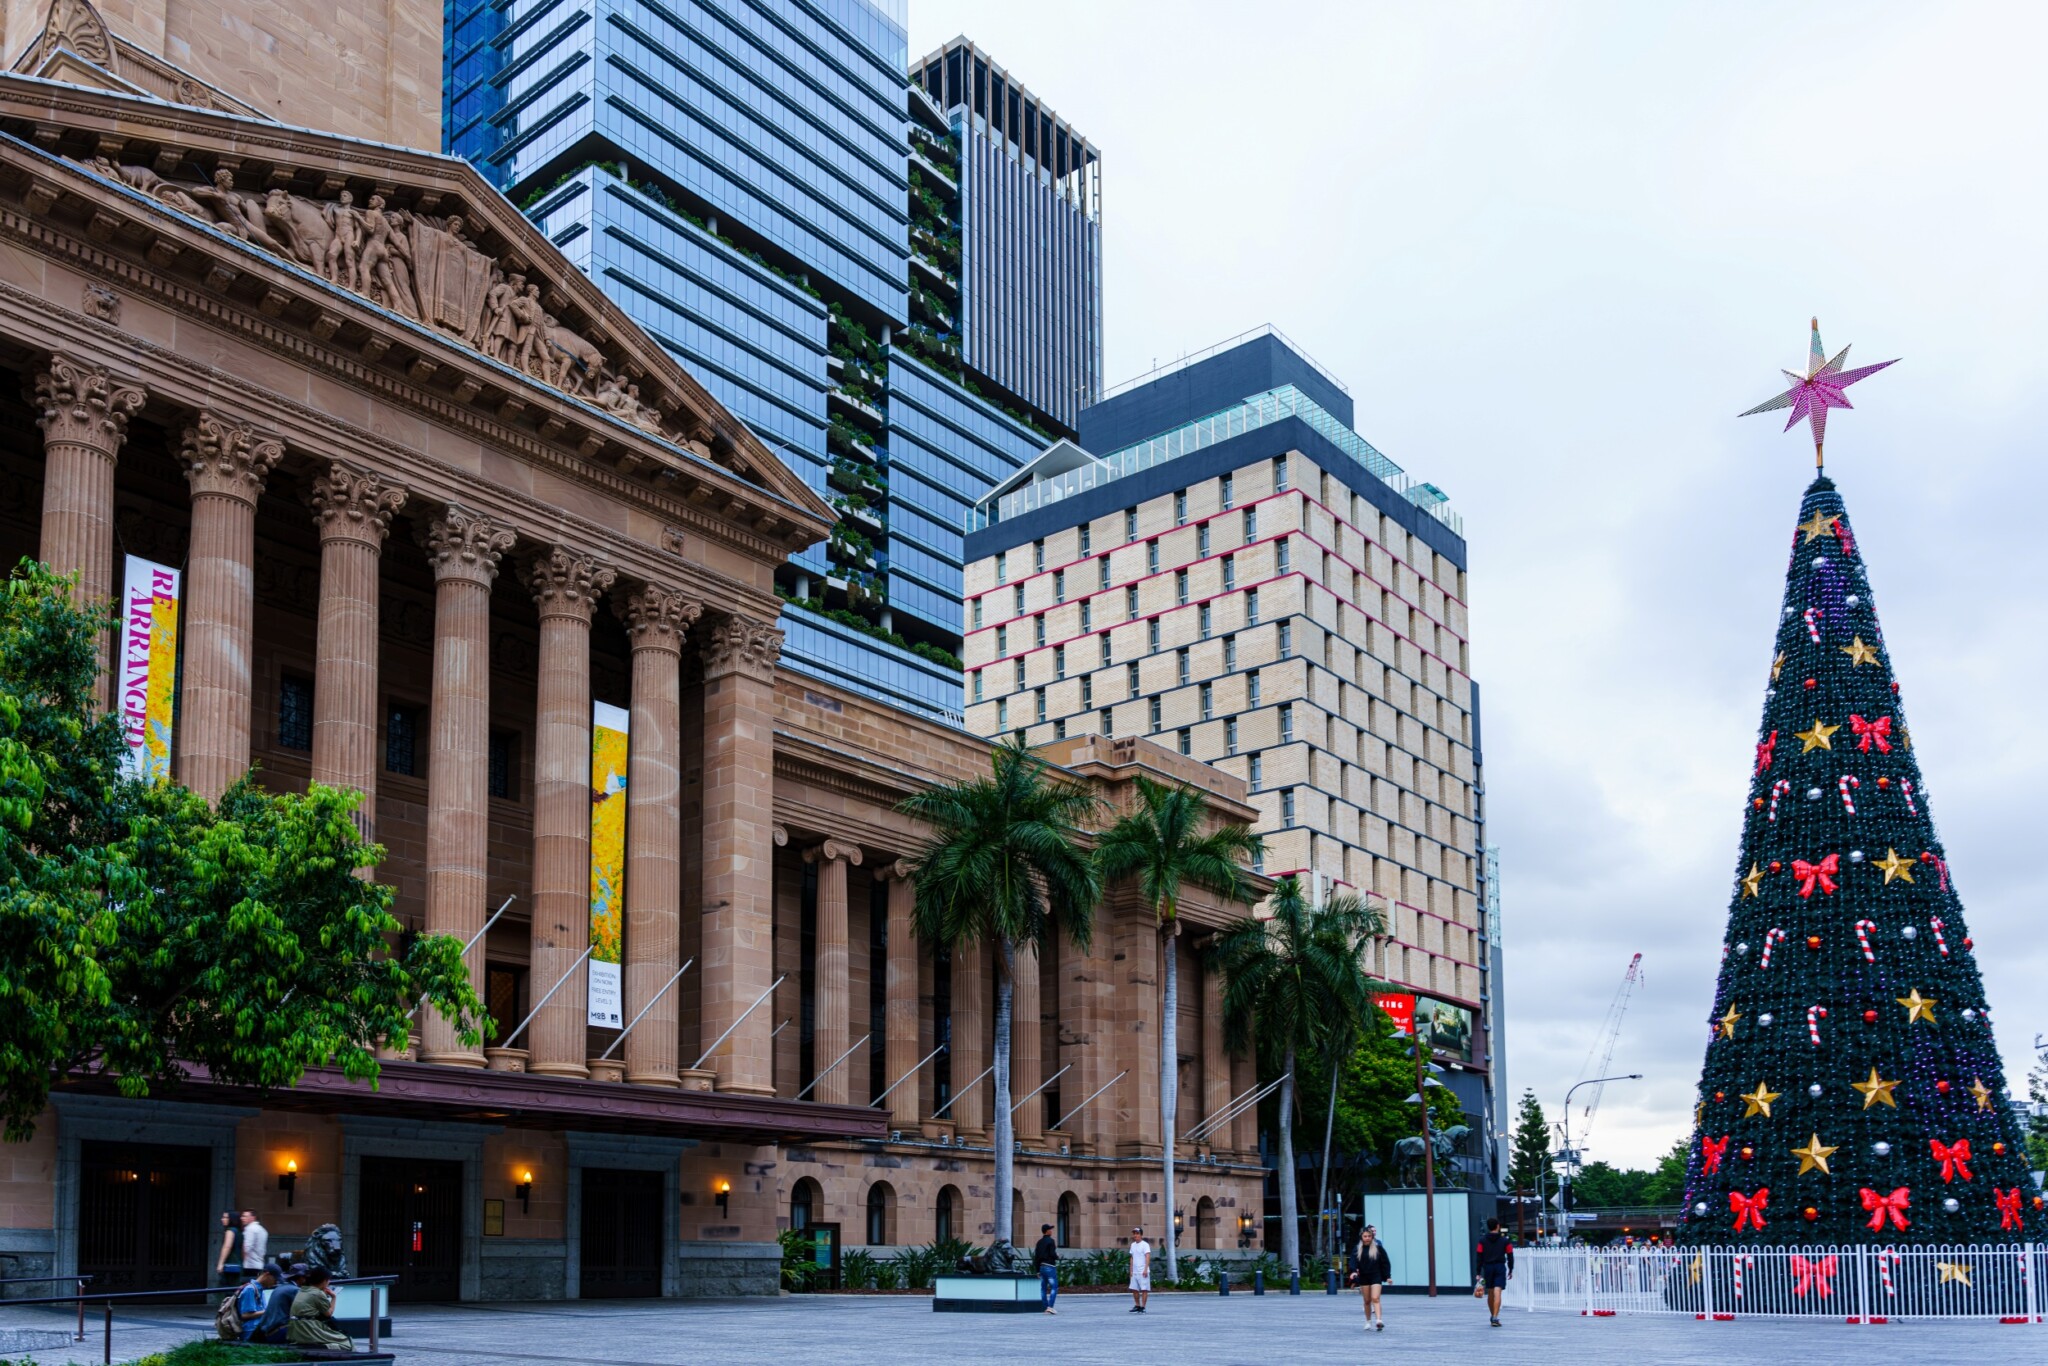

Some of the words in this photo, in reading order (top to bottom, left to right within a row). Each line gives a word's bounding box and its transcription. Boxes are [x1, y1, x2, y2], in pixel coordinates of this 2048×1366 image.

[152, 568, 174, 611] RE
[124, 586, 154, 748] ARRANGED
[592, 970, 616, 979] EXHIBITION
